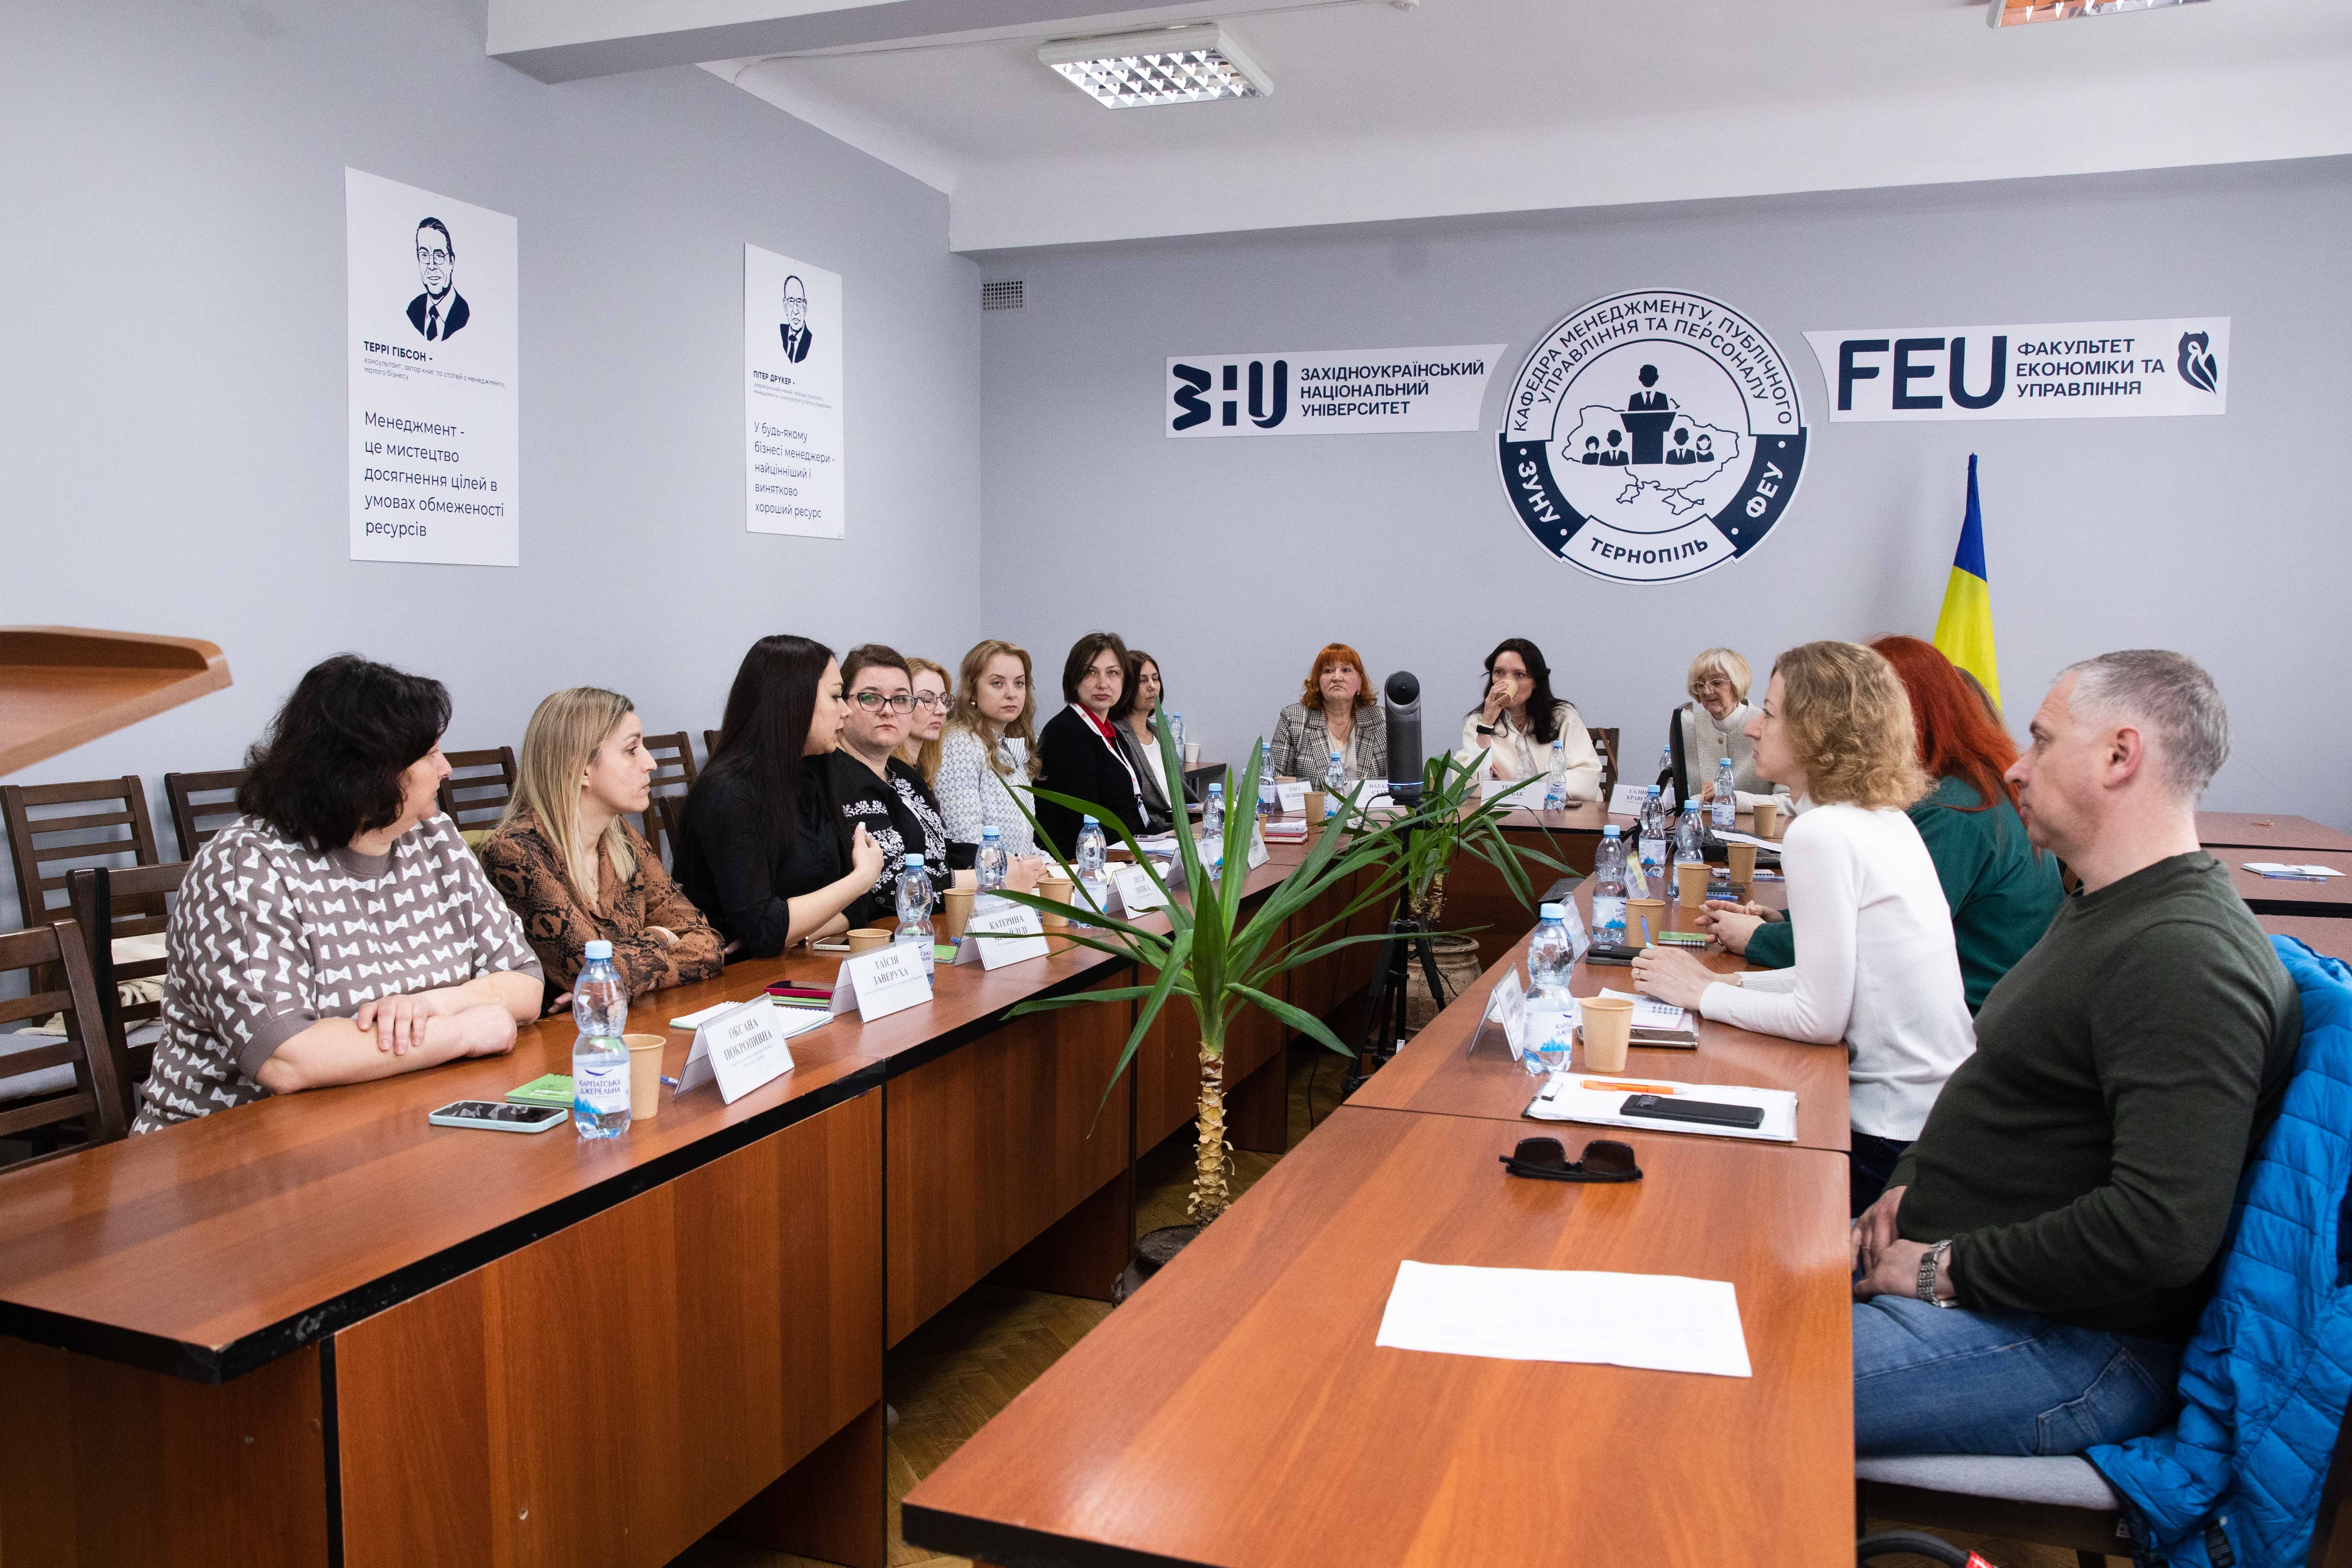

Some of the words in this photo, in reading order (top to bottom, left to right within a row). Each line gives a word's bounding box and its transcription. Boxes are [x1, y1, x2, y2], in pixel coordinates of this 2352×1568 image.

[364, 341, 389, 355] ТЕРРІ
[392, 346, 426, 362] ГІБСОН
[2016, 339, 2135, 356] ФАКУЛЬТЕТ
[404, 365, 421, 374] автор
[1300, 360, 1484, 381] ЗАХІДНОУКРАЇНСЬКИЙ
[1514, 348, 1562, 432] КАФЕДРА
[1559, 299, 1713, 348] МЕНЕДЖМЕНТУ,
[1718, 317, 1792, 425] ПУБЛІЧНОГО
[1537, 318, 1640, 404] УПРАВЛІННЯ
[1644, 317, 1668, 331] ТА
[1673, 319, 1769, 400] ПЕРСОНАЛУ
[2015, 360, 2134, 377] ЕКОНОМІКИ
[2141, 359, 2165, 374] ТА
[364, 367, 386, 376] малого
[387, 370, 409, 381] бізнесу
[754, 371, 769, 380] ПІТЕР
[770, 375, 792, 385] ДРУКЕР
[1837, 335, 2008, 410] FEU
[1300, 380, 1429, 401] НАЦІОНАЛЬНИЙ
[2016, 381, 2142, 398] УПРАВЛІННЯ
[1302, 401, 1410, 417] УНІВЕРСИТЕТ
[365, 411, 457, 437] Менеджмент
[754, 421, 760, 432] У
[762, 423, 808, 443] будь-якому
[365, 441, 382, 455] це
[387, 444, 459, 462] мистецтво
[755, 441, 783, 456] бізнесі
[785, 448, 830, 464] менеджери
[365, 468, 446, 487] досягнення
[452, 474, 486, 491] цілей
[491, 481, 498, 491] в
[755, 463, 807, 479] найцінніший
[755, 483, 798, 496] винятково
[1517, 460, 1561, 523] ЗУНУ
[1746, 461, 1783, 518] ФЕУ
[365, 495, 415, 510] умовах
[419, 496, 504, 516] обмеженості
[755, 503, 792, 515] хороший
[795, 508, 821, 519] ресурс
[366, 521, 427, 538] ресурсів
[1590, 537, 1709, 564] ТЕРНОПІЛЬ
[989, 914, 1024, 930] КАТЕРИНА
[874, 955, 900, 970] ТАЇСІЯ
[872, 968, 909, 985] ЗАВЕРУХА
[728, 1018, 759, 1039] ОКСАНА
[723, 1029, 773, 1061] ПОКРОПИВНА
[579, 1079, 621, 1087] КАРПАТСЬКА
[580, 1087, 621, 1095] ДЖЕРЕЛЬНА
